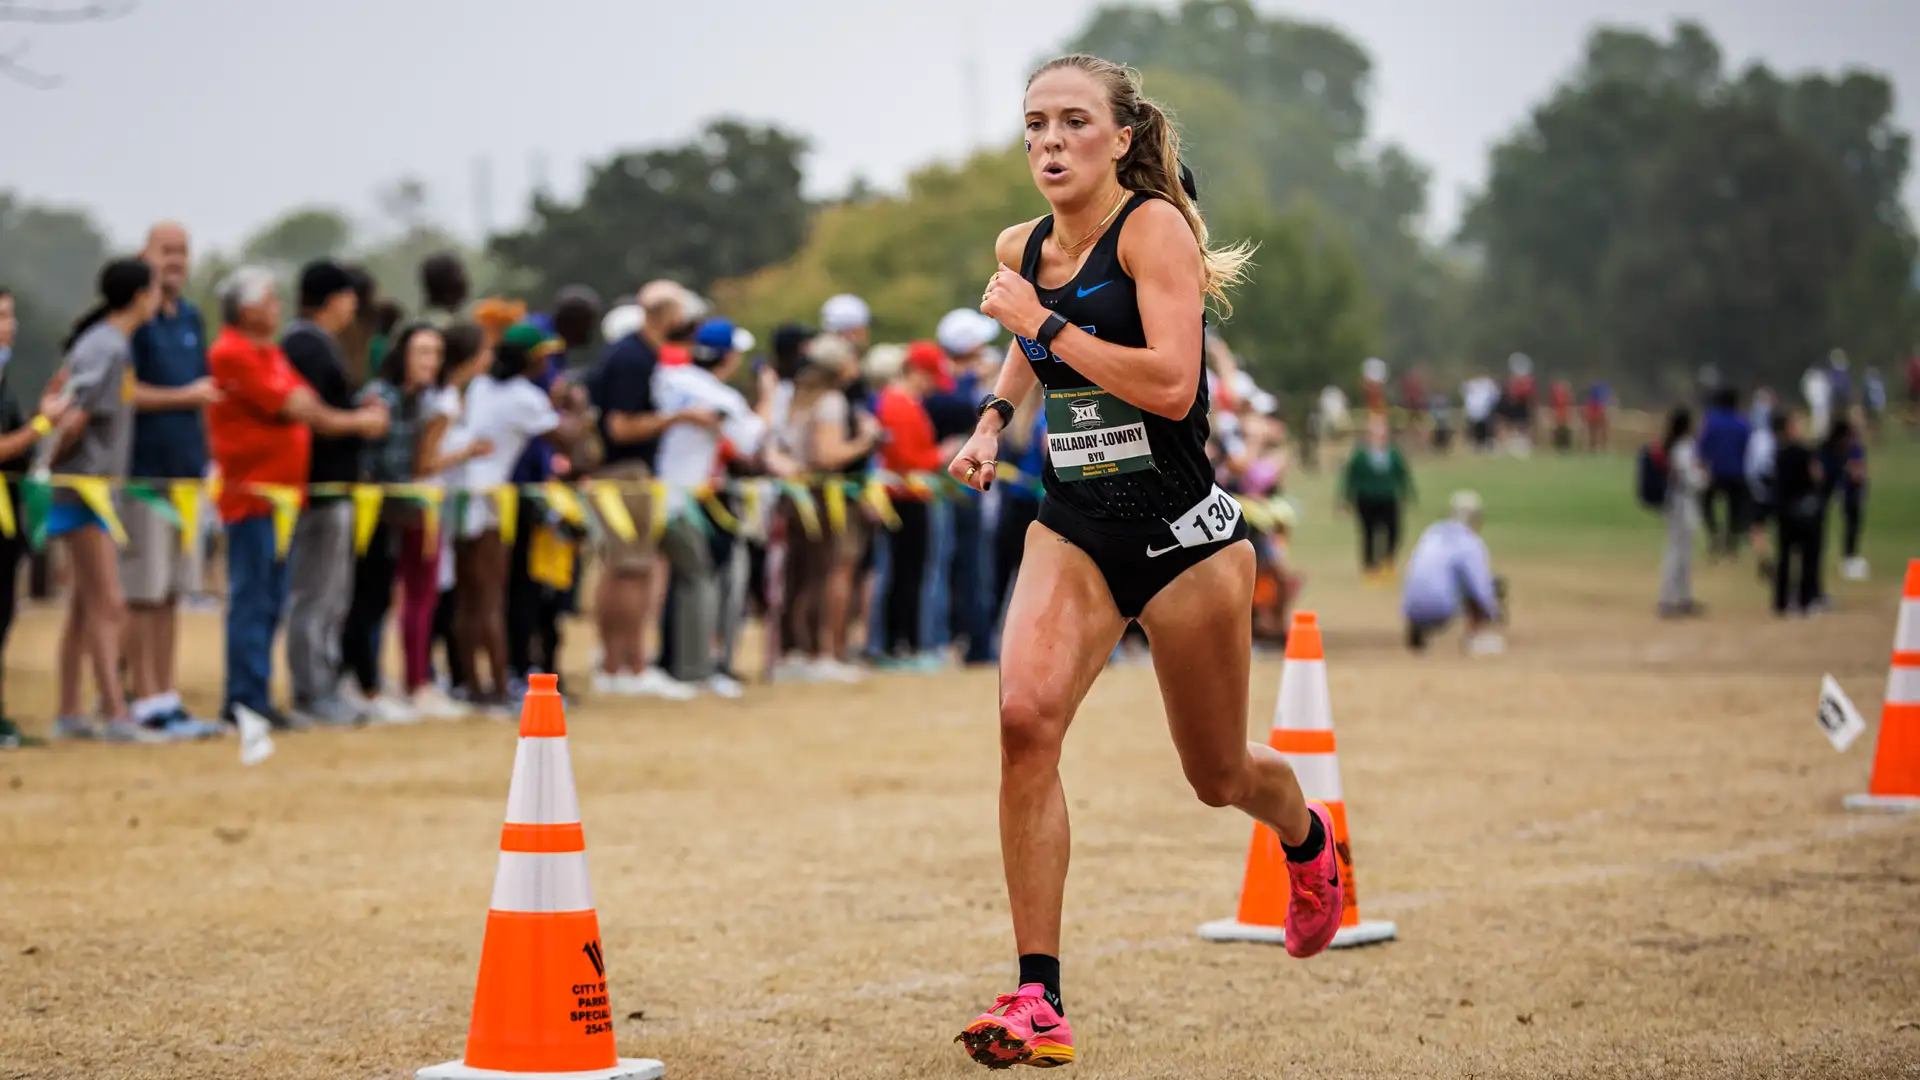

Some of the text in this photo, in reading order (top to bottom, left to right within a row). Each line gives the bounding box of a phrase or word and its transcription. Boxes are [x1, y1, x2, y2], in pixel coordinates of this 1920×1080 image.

[1050, 427, 1143, 452] HALLADAY-LOWRY
[1088, 451, 1105, 463] BYU
[1192, 494, 1235, 542] 130
[572, 984, 597, 995] CITY
